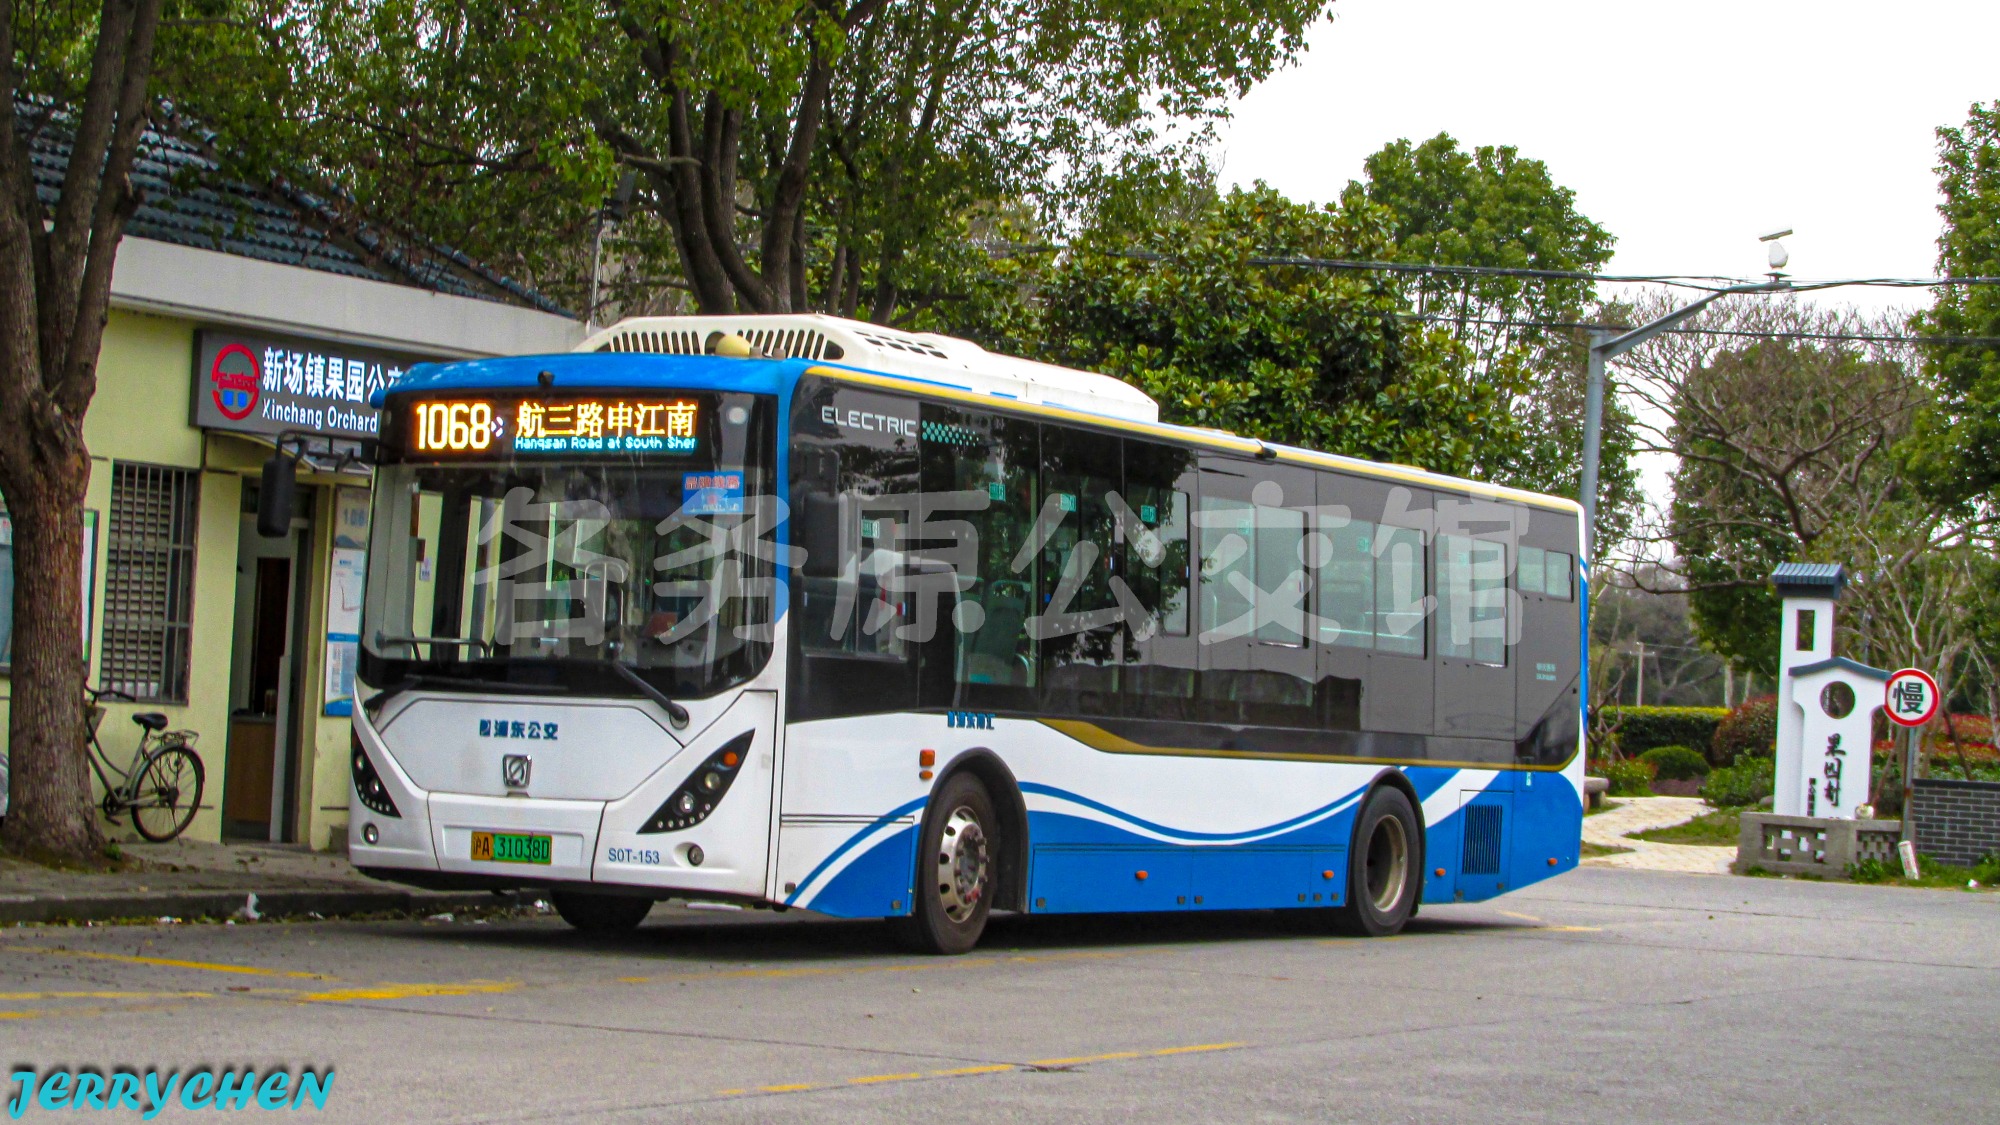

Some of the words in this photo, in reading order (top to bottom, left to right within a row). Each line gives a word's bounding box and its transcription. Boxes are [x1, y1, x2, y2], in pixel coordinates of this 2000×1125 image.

[262, 398, 322, 430] Xinchang
[327, 406, 379, 432] Orchard
[416, 403, 491, 450] 1068
[516, 400, 697, 438] 航三路申江南
[821, 405, 917, 438] ELECTRIC
[571, 436, 603, 449] Road
[607, 437, 622, 449] at
[625, 436, 662, 449] South
[1893, 681, 1924, 714] 慢
[494, 719, 559, 740] 浦东公交
